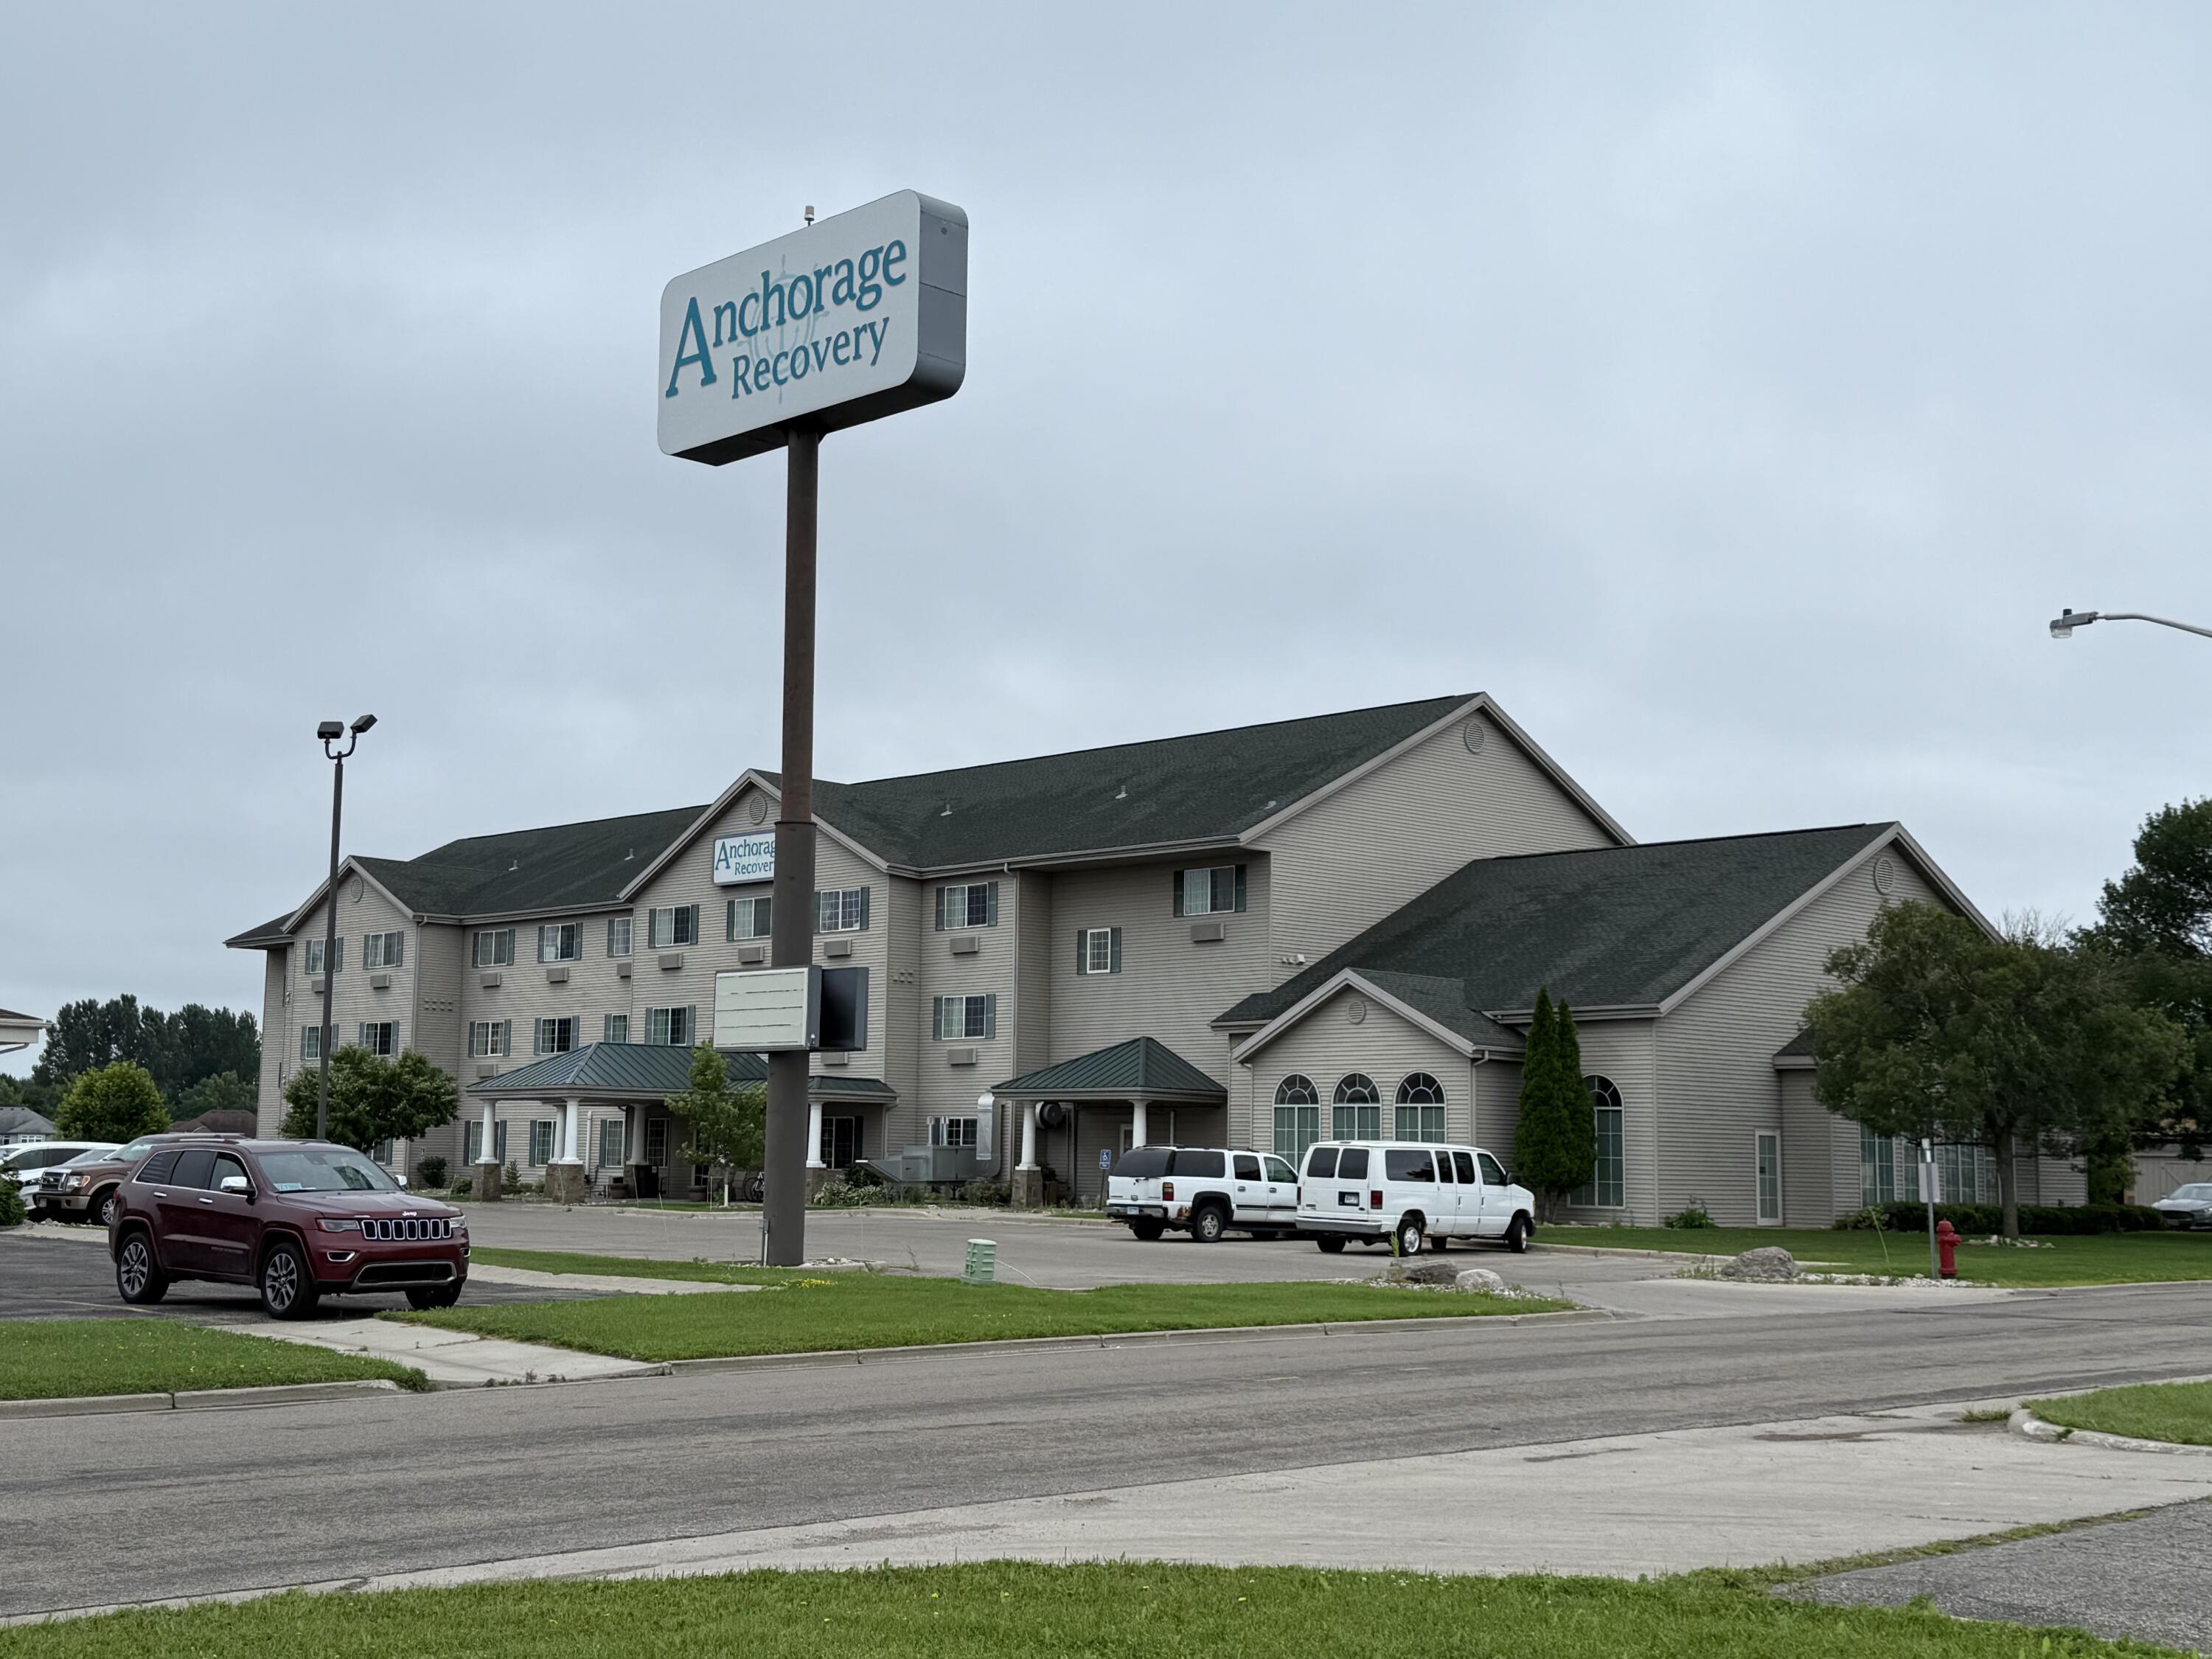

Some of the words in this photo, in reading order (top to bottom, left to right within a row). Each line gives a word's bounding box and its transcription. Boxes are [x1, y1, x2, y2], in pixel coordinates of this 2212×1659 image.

[665, 239, 907, 398] Anchorage
[731, 316, 890, 400] Recovery
[714, 838, 775, 870] Anchorag
[734, 860, 774, 875] Recover
